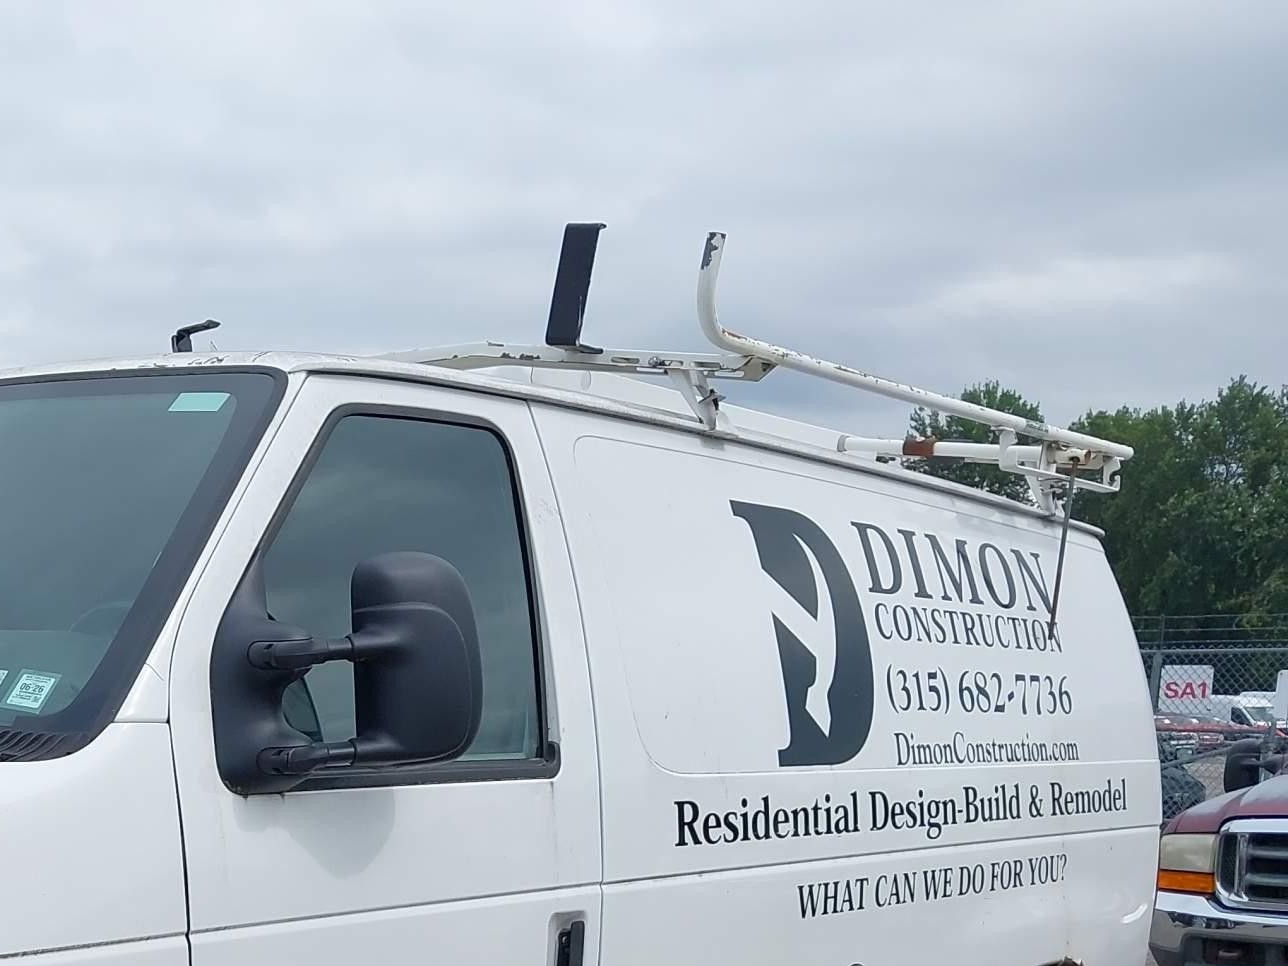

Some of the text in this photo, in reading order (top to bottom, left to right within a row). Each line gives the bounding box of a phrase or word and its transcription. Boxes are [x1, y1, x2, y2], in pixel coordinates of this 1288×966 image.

[850, 521, 1054, 614] DIMON
[874, 602, 1063, 653] CONSTRUCTION
[886, 664, 1072, 715] (315) 682-7736
[1164, 681, 1208, 699] SA1
[894, 731, 1080, 766] DimonConstruction.com
[674, 778, 1127, 847] Residential Design-Build & Remodel
[797, 854, 1067, 919] WHAT CAN WE DO FOR YOU?
